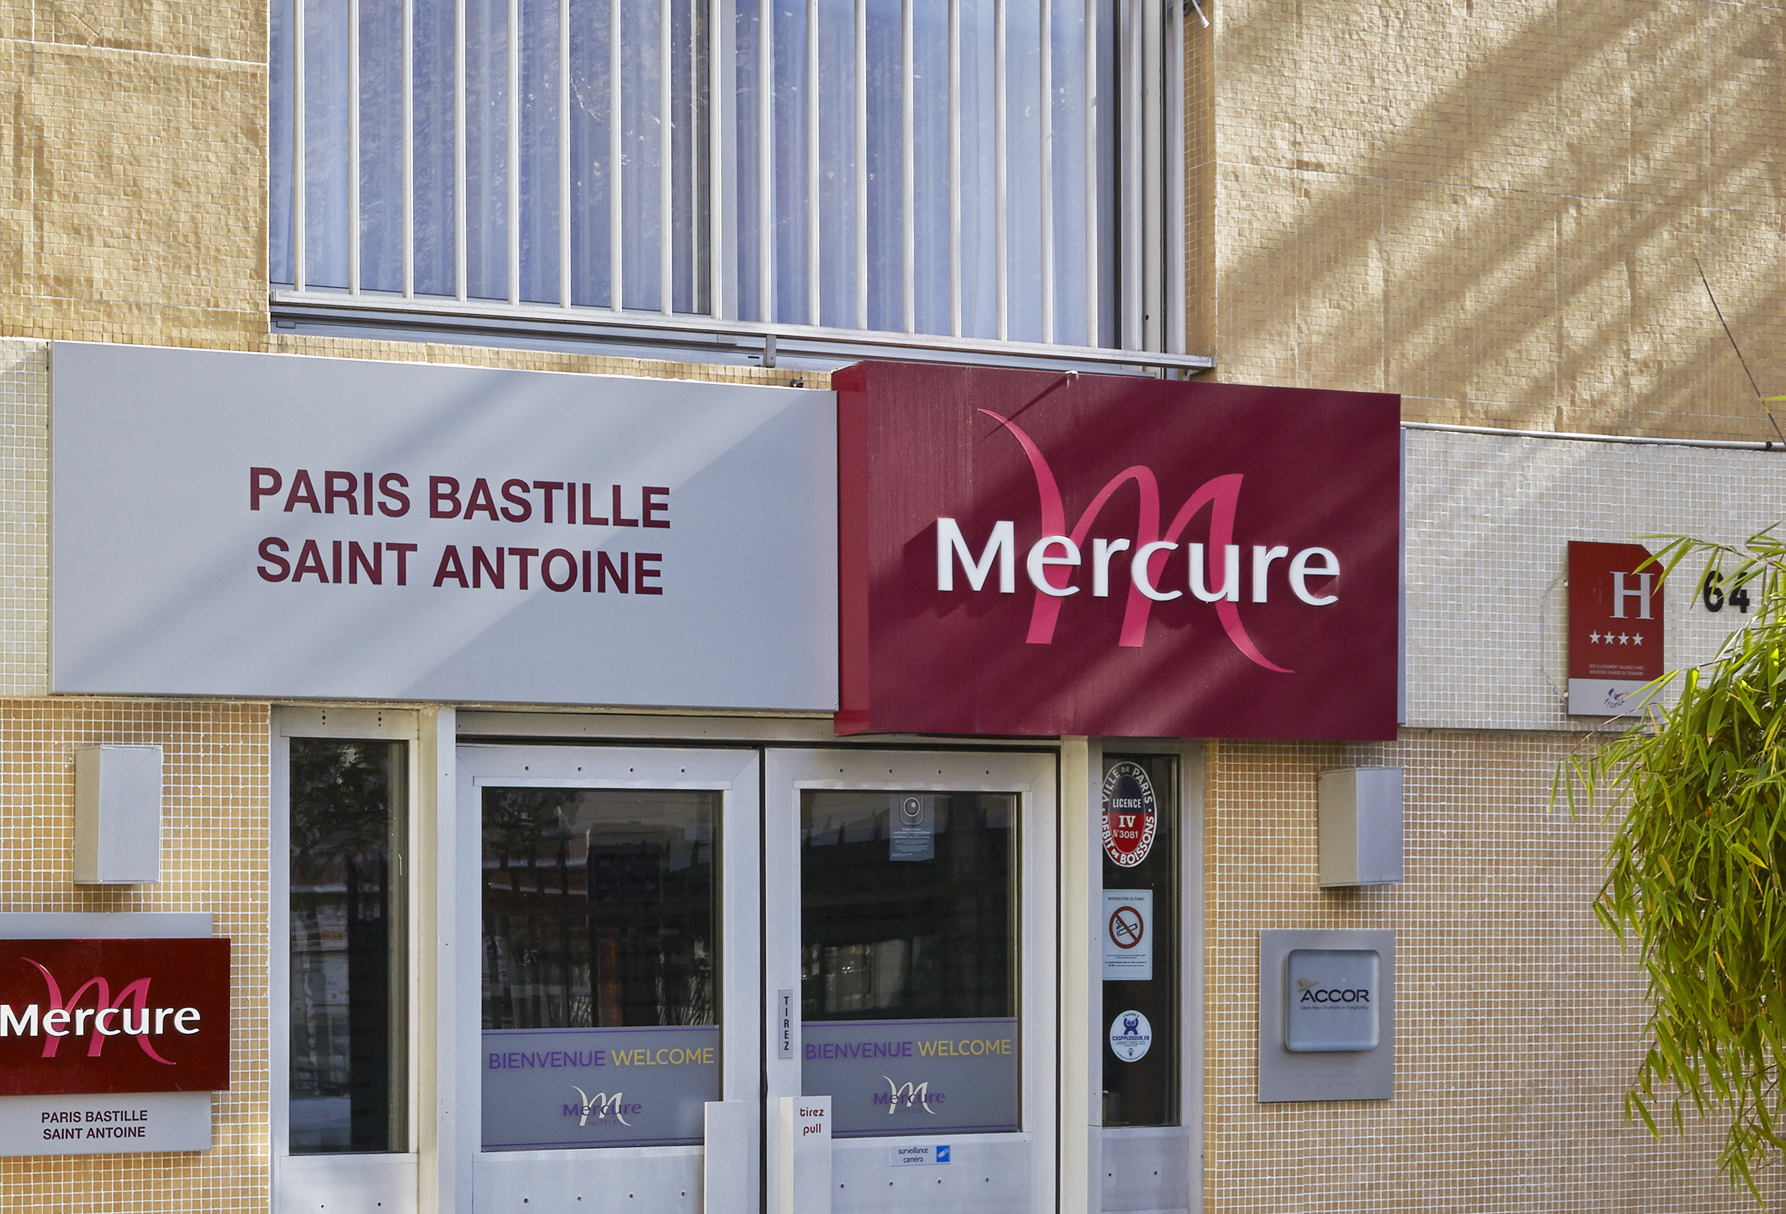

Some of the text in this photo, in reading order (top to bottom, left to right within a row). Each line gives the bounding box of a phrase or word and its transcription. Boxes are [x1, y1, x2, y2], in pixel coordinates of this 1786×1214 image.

[250, 467, 671, 529] PARIS BASTILLE
[256, 536, 664, 595] SAINT ANTOINE
[936, 517, 1341, 606] Mercure
[1609, 571, 1654, 620] H
[1703, 570, 1750, 613] 64
[1102, 768, 1120, 803] VILLE
[1132, 767, 1153, 804] PARIS
[1112, 799, 1142, 808] LICENCE
[1119, 815, 1136, 828] IV
[1102, 815, 1154, 864] DEBIT DE BOISSONS
[1300, 989, 1370, 1003] ACCOR
[0, 1003, 201, 1037] Mercure
[488, 1048, 714, 1069] BIENVENUE WELCOME
[805, 1039, 1012, 1060] BIENVENUE WELCOME
[873, 1092, 946, 1105] Mercure
[41, 1110, 148, 1123] PARIS BASTILLE
[563, 1102, 642, 1117] Mercure
[799, 1107, 825, 1117] tirez
[43, 1126, 146, 1140] SAINT ANTOINE
[803, 1124, 822, 1136] pull
[898, 1147, 929, 1155] surveillance
